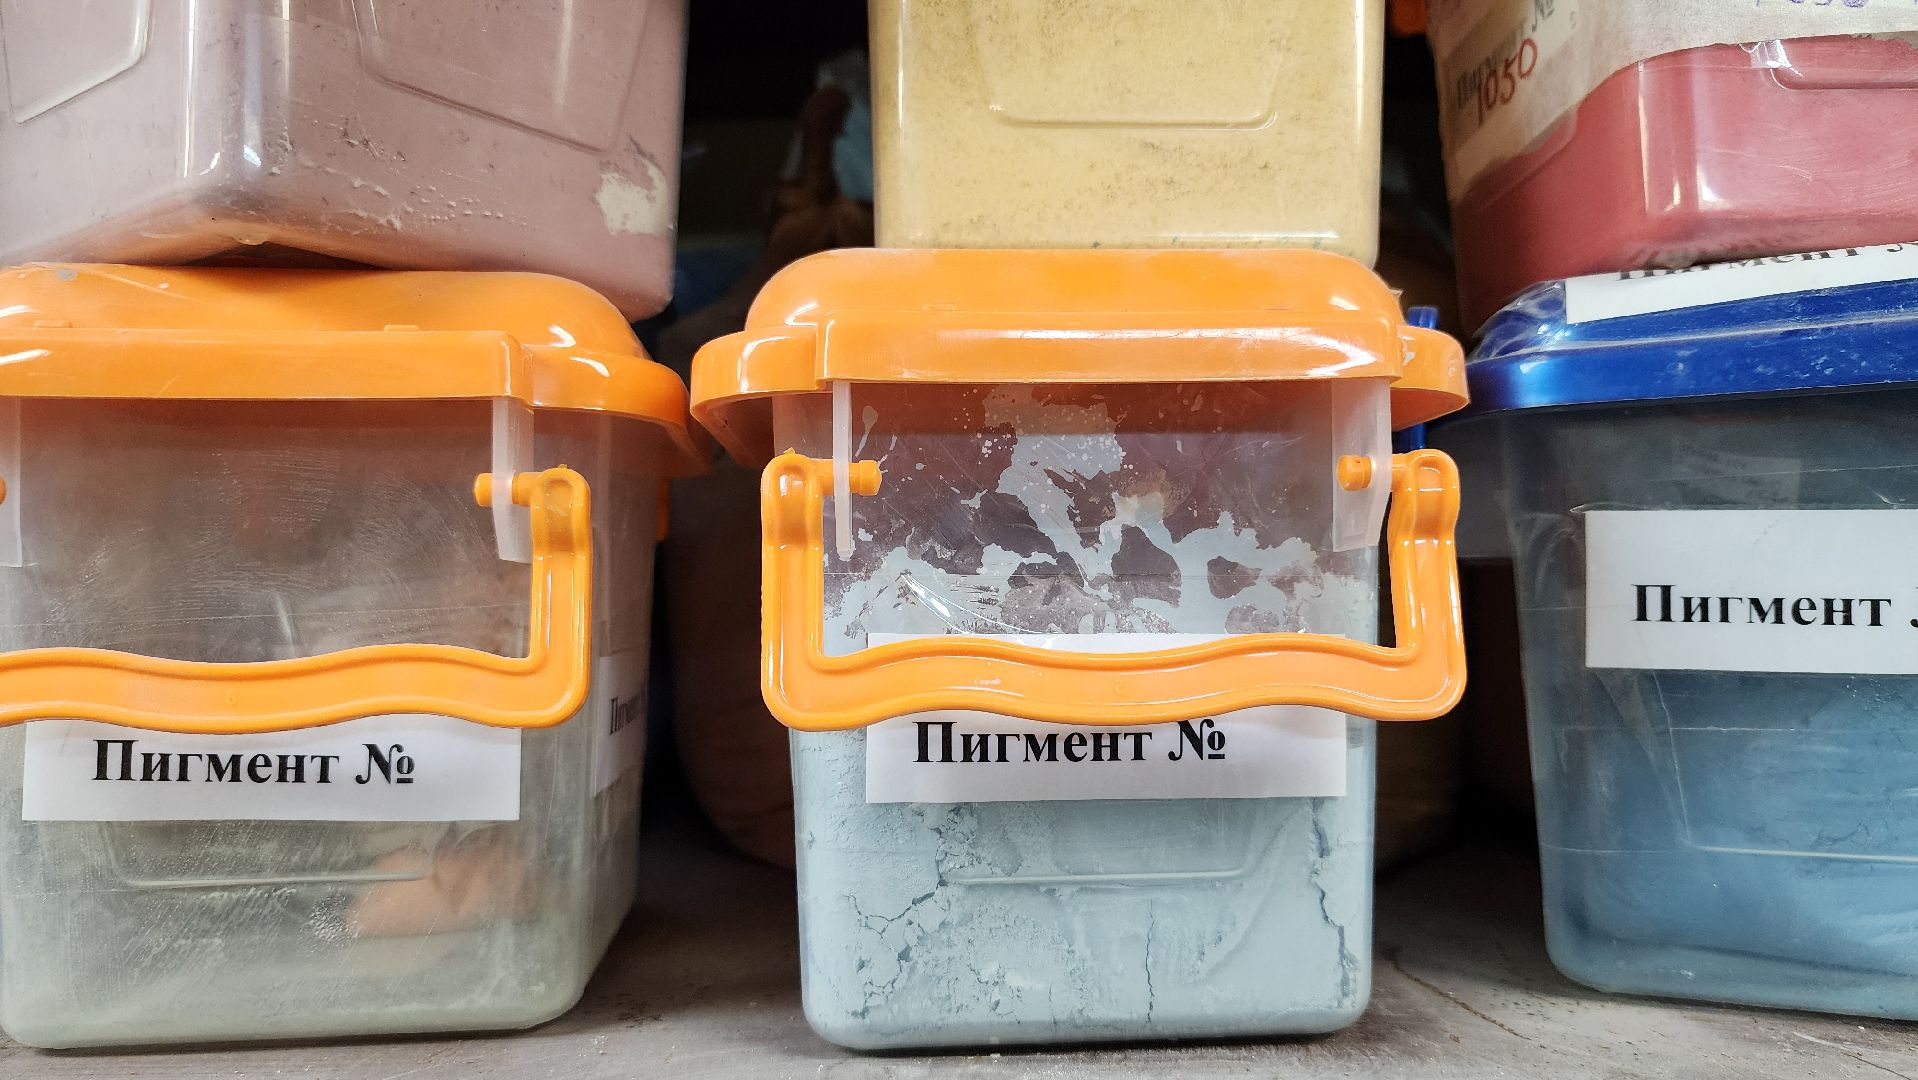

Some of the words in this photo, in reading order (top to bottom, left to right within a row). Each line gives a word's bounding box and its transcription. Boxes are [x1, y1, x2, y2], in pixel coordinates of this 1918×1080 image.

[1630, 584, 1892, 627] Пигмент
[91, 739, 340, 785] Пигмент
[354, 743, 415, 785] №
[912, 721, 1153, 763] Пигмент
[1167, 718, 1226, 761] №
